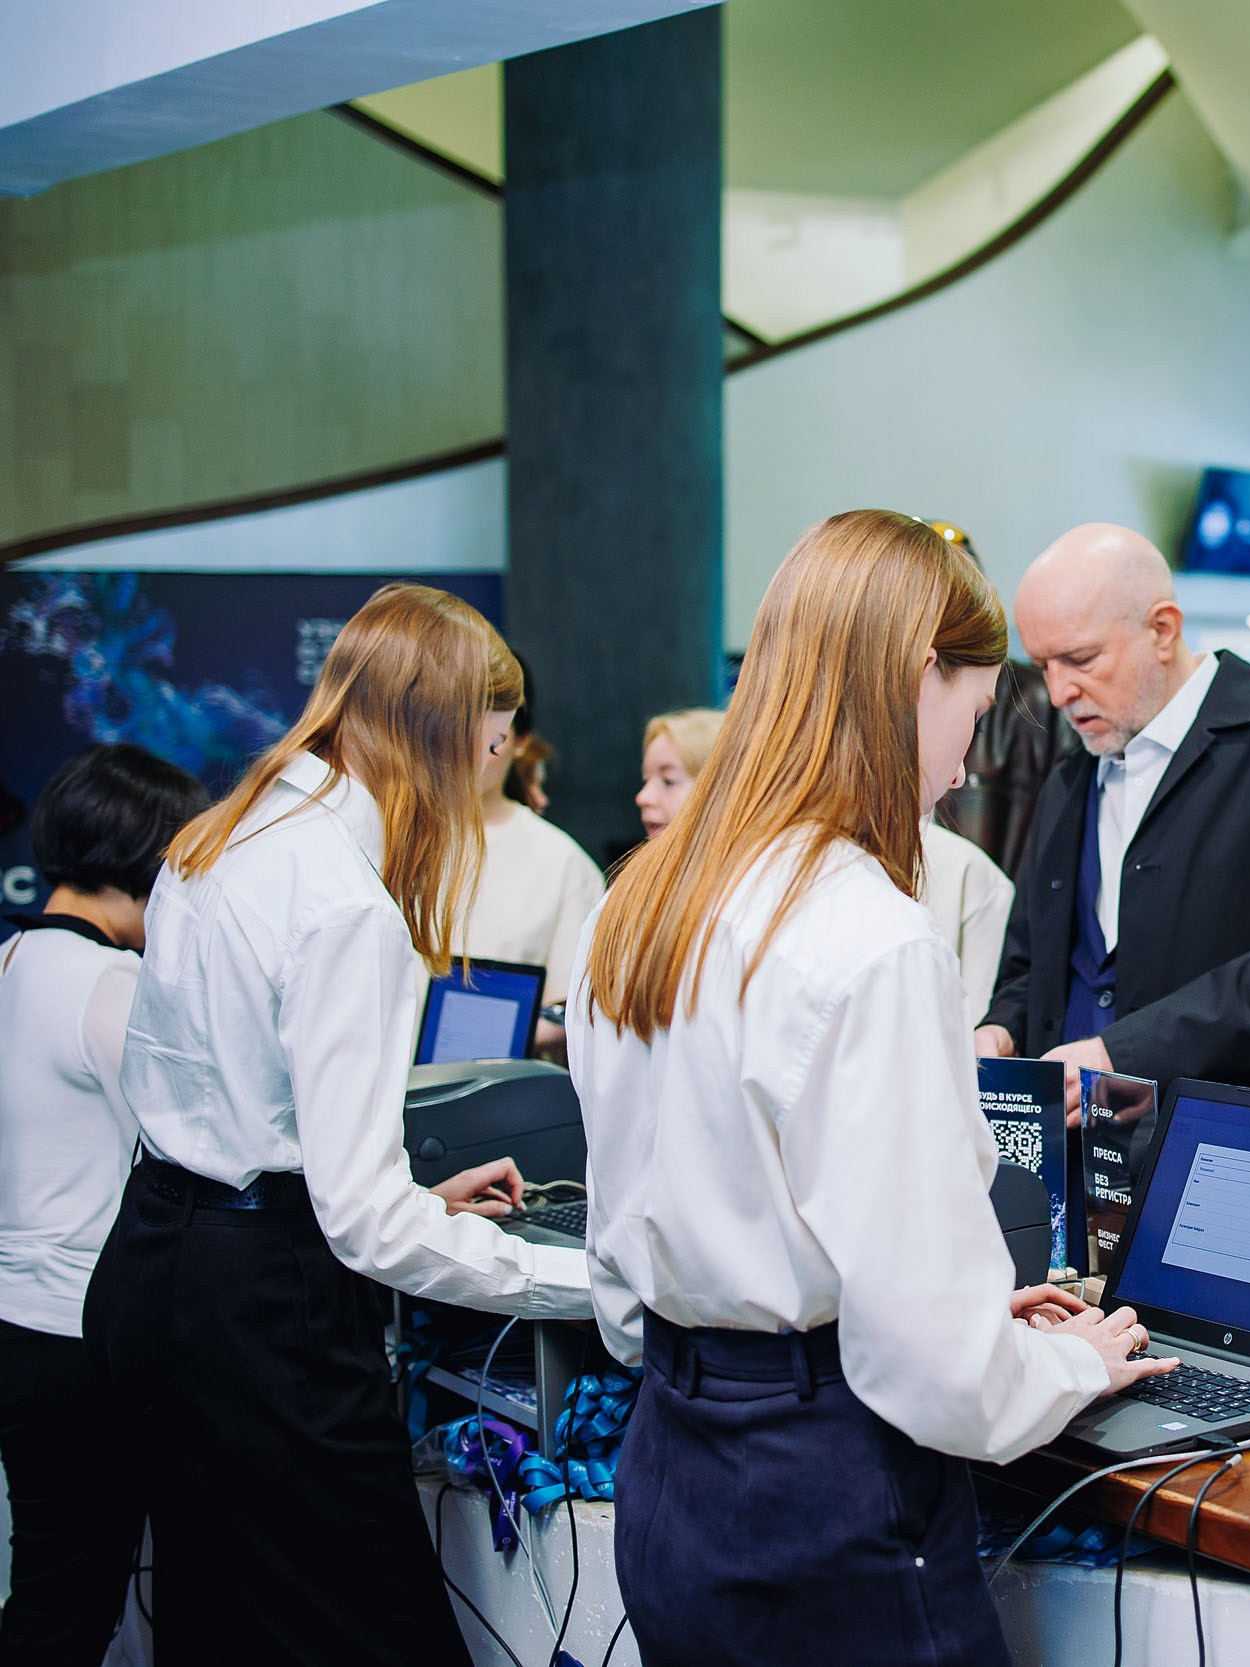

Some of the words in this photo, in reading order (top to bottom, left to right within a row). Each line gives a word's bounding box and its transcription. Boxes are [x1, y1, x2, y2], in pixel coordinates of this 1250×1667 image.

[998, 1093, 1005, 1101] В
[1005, 1093, 1033, 1103] КУРСЕ
[979, 1102, 1042, 1114] ОИСХОДЯЩЕГО
[1098, 1107, 1113, 1119] СБЕР
[1093, 1146, 1123, 1165] ПРЕССА
[1094, 1173, 1109, 1187] БЕЗ
[1095, 1186, 1132, 1206] РЕГИСТРА
[1097, 1228, 1120, 1243] БИЗНЕС
[1098, 1239, 1114, 1251] ФЕСТ
